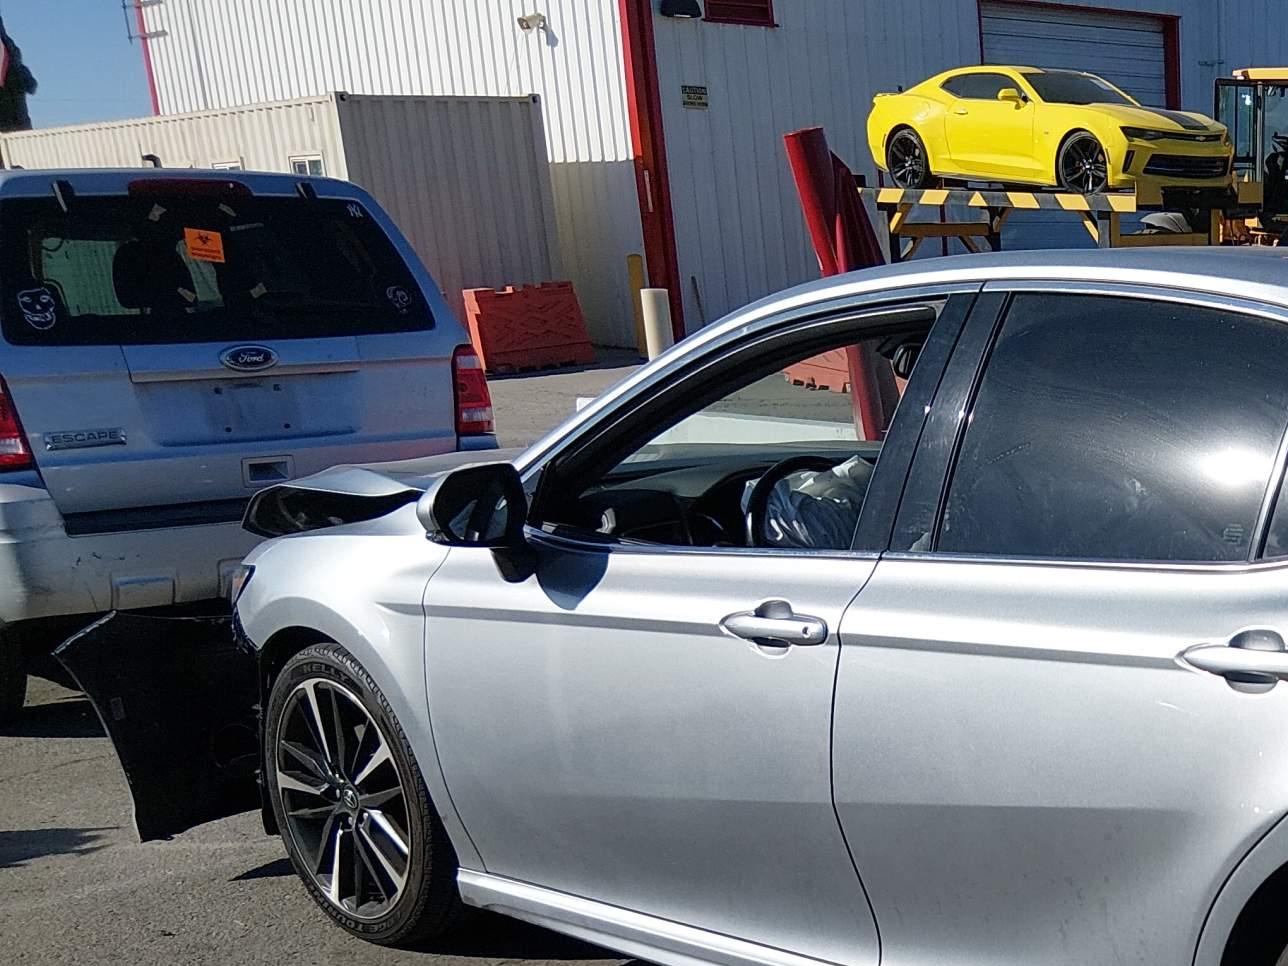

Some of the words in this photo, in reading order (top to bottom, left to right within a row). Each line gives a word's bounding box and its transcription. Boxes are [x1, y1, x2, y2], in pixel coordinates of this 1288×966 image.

[239, 351, 265, 363] Ford
[51, 431, 118, 444] ESCAPE
[303, 663, 350, 681] KELLY
